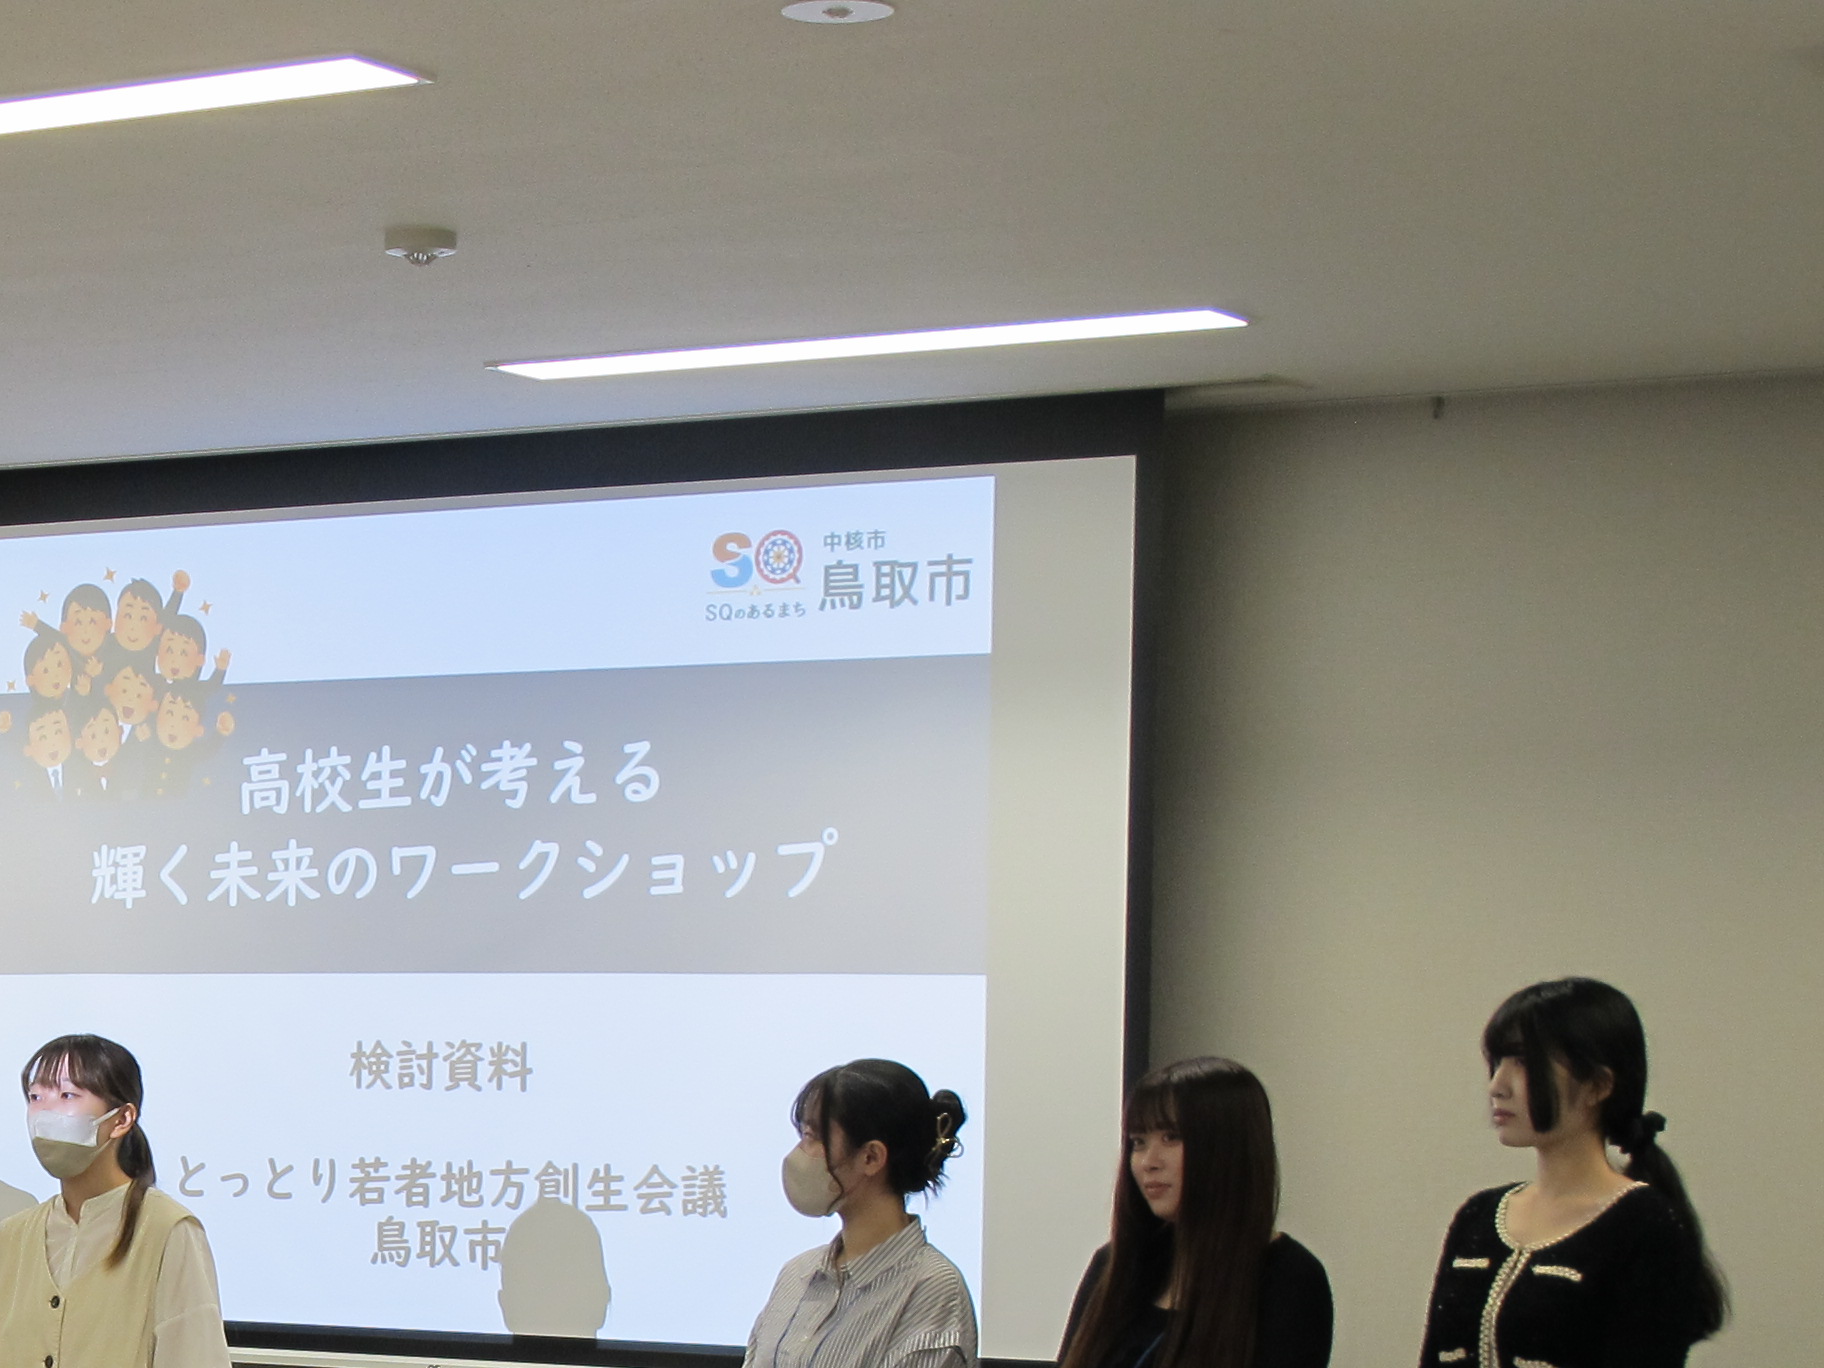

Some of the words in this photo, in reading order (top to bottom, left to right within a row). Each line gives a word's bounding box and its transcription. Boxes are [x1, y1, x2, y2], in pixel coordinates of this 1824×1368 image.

[823, 529, 887, 553] 中核市
[705, 601, 807, 621] SQのあるまち
[818, 553, 974, 612] 鳥取市
[239, 740, 661, 816] 高校生が考える
[89, 827, 839, 910] 輝く未来のワークショップ
[349, 1039, 534, 1093] 検討資料
[177, 1154, 728, 1219] とっとり若者地方創生会議
[370, 1216, 507, 1271] 鳥取市
